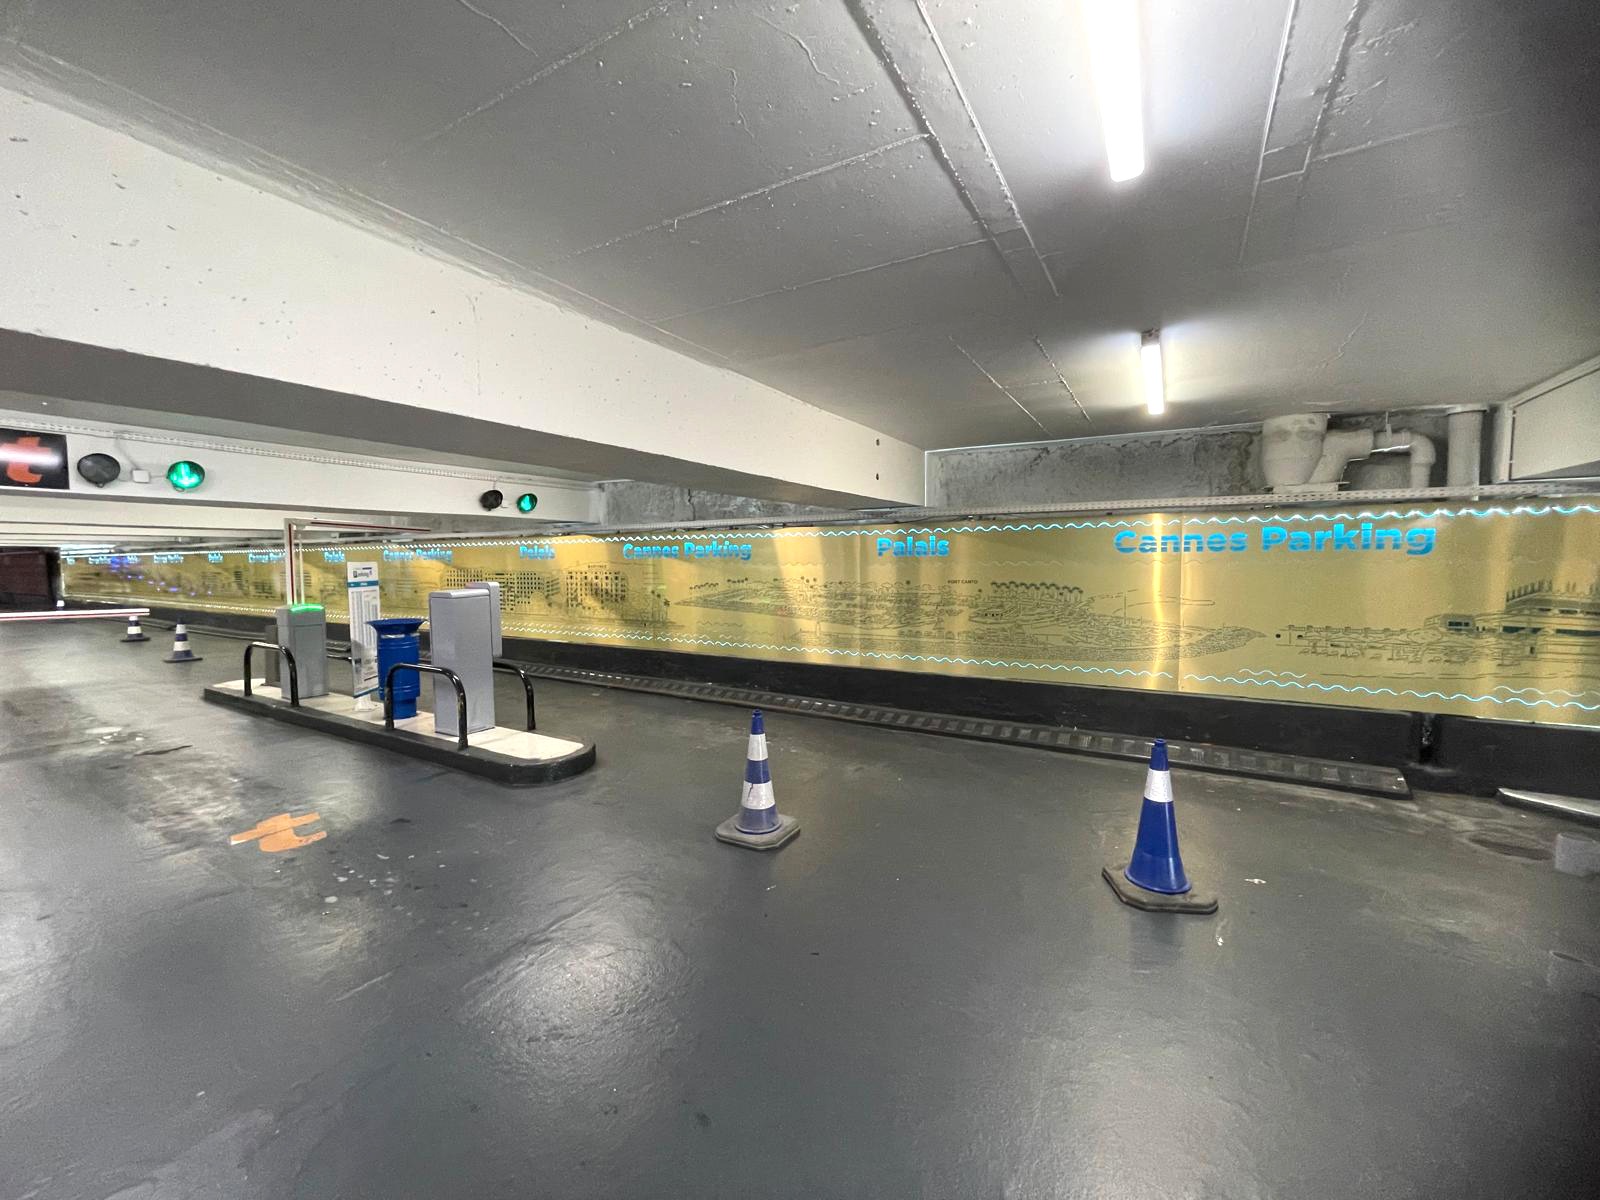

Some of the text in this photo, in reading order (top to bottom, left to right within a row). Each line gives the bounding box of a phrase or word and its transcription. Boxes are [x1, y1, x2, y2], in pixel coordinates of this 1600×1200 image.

[876, 535, 950, 557] Palais
[1113, 523, 1437, 556] Cannes Parking
[519, 544, 556, 560] Palais
[622, 540, 753, 561] Cannes Parking
